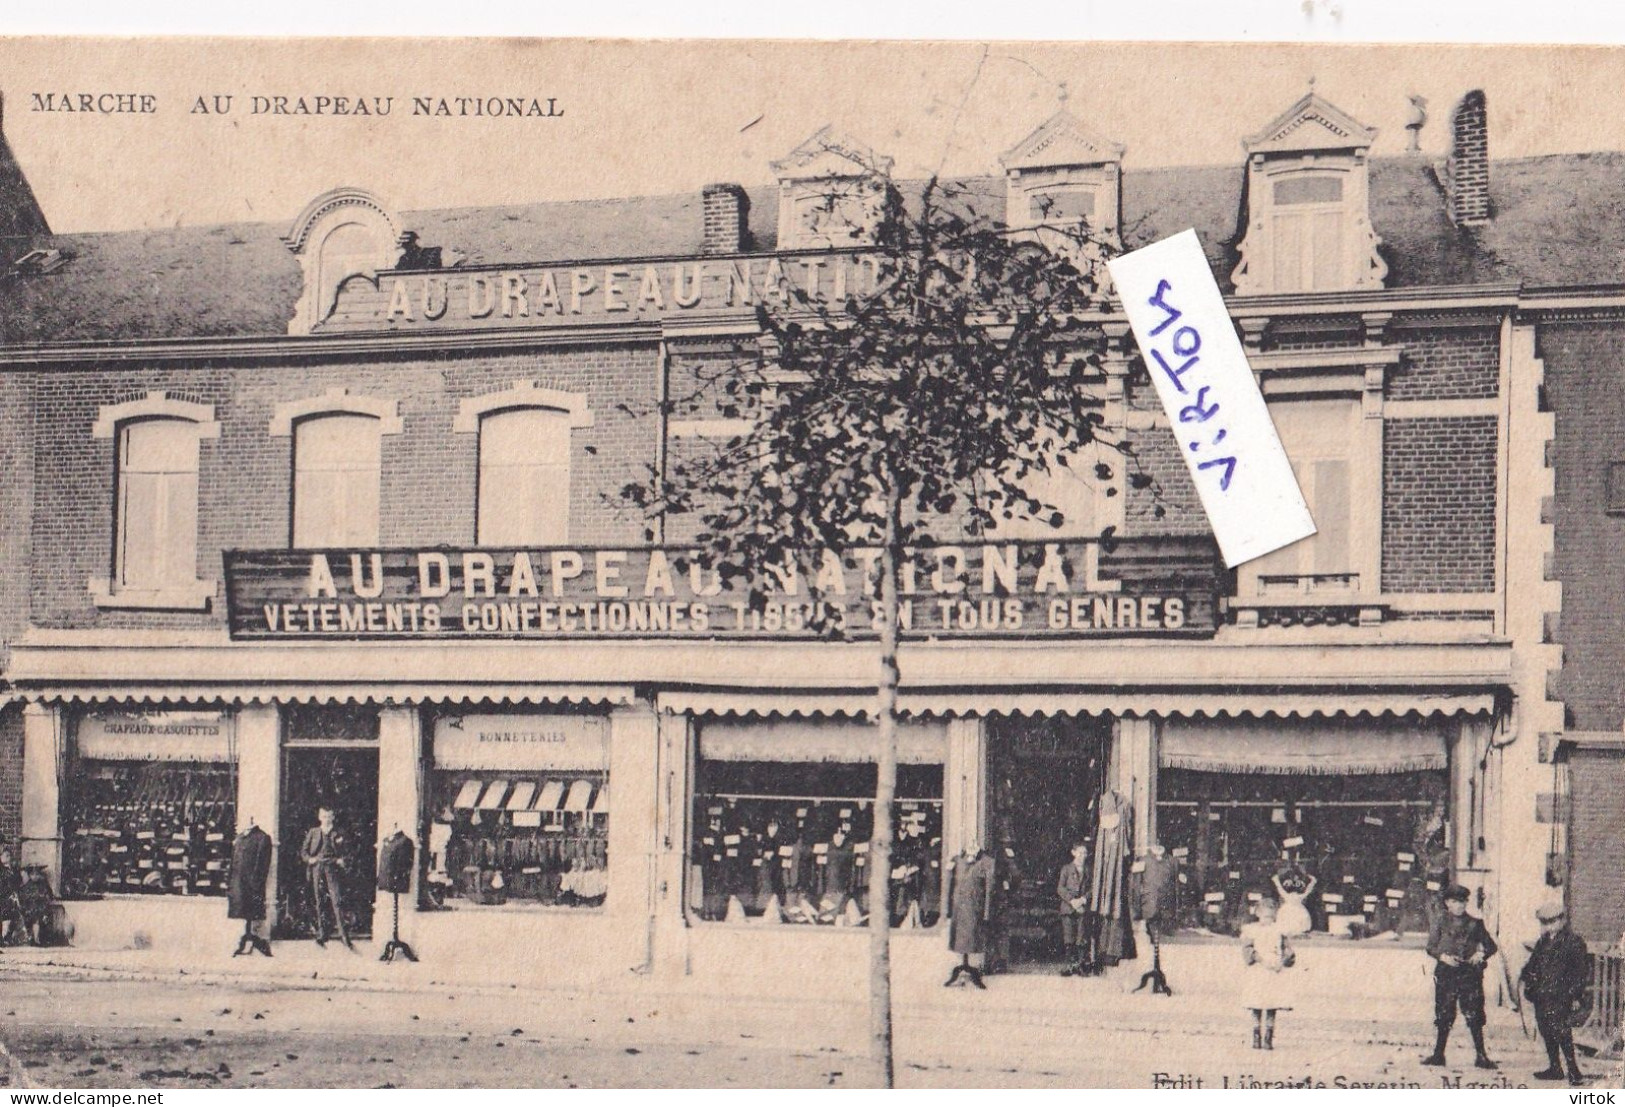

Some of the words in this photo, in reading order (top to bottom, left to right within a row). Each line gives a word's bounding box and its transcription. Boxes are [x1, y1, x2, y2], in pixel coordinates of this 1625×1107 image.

[386, 277, 449, 323] AU
[467, 264, 704, 319] DRAPEAU
[308, 552, 384, 599] AU
[417, 549, 723, 599] DRAPEAU
[762, 543, 1122, 597] NATIONAL
[263, 601, 441, 633] VETEMENTS
[462, 601, 710, 633] CONFECTIONNES
[937, 598, 1024, 630] TOUS
[1049, 597, 1185, 629] GENRES
[479, 731, 567, 743] BONNETERIES
